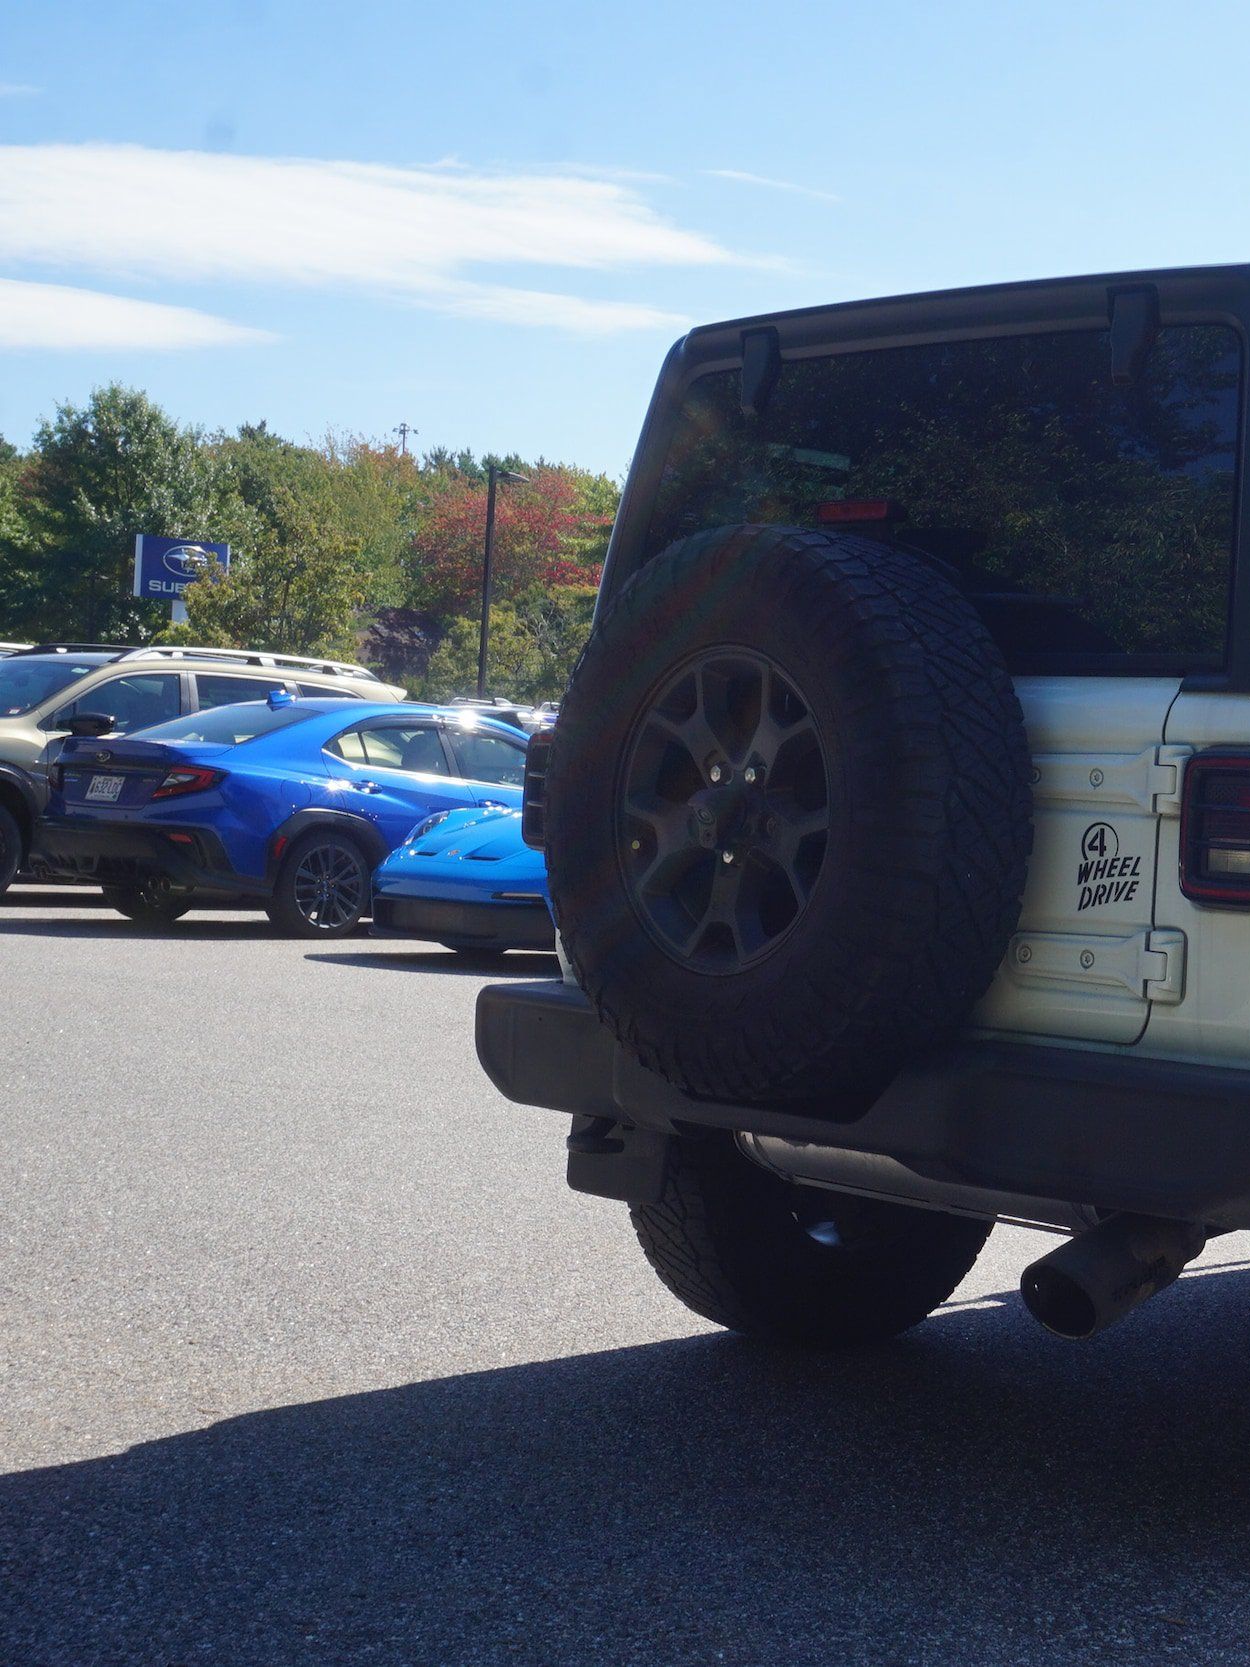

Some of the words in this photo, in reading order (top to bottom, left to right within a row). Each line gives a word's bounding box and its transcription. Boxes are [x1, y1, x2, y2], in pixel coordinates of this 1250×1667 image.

[1087, 827, 1107, 858] 4
[1077, 856, 1141, 886] WHEEL
[1077, 880, 1140, 912] DRIVE
